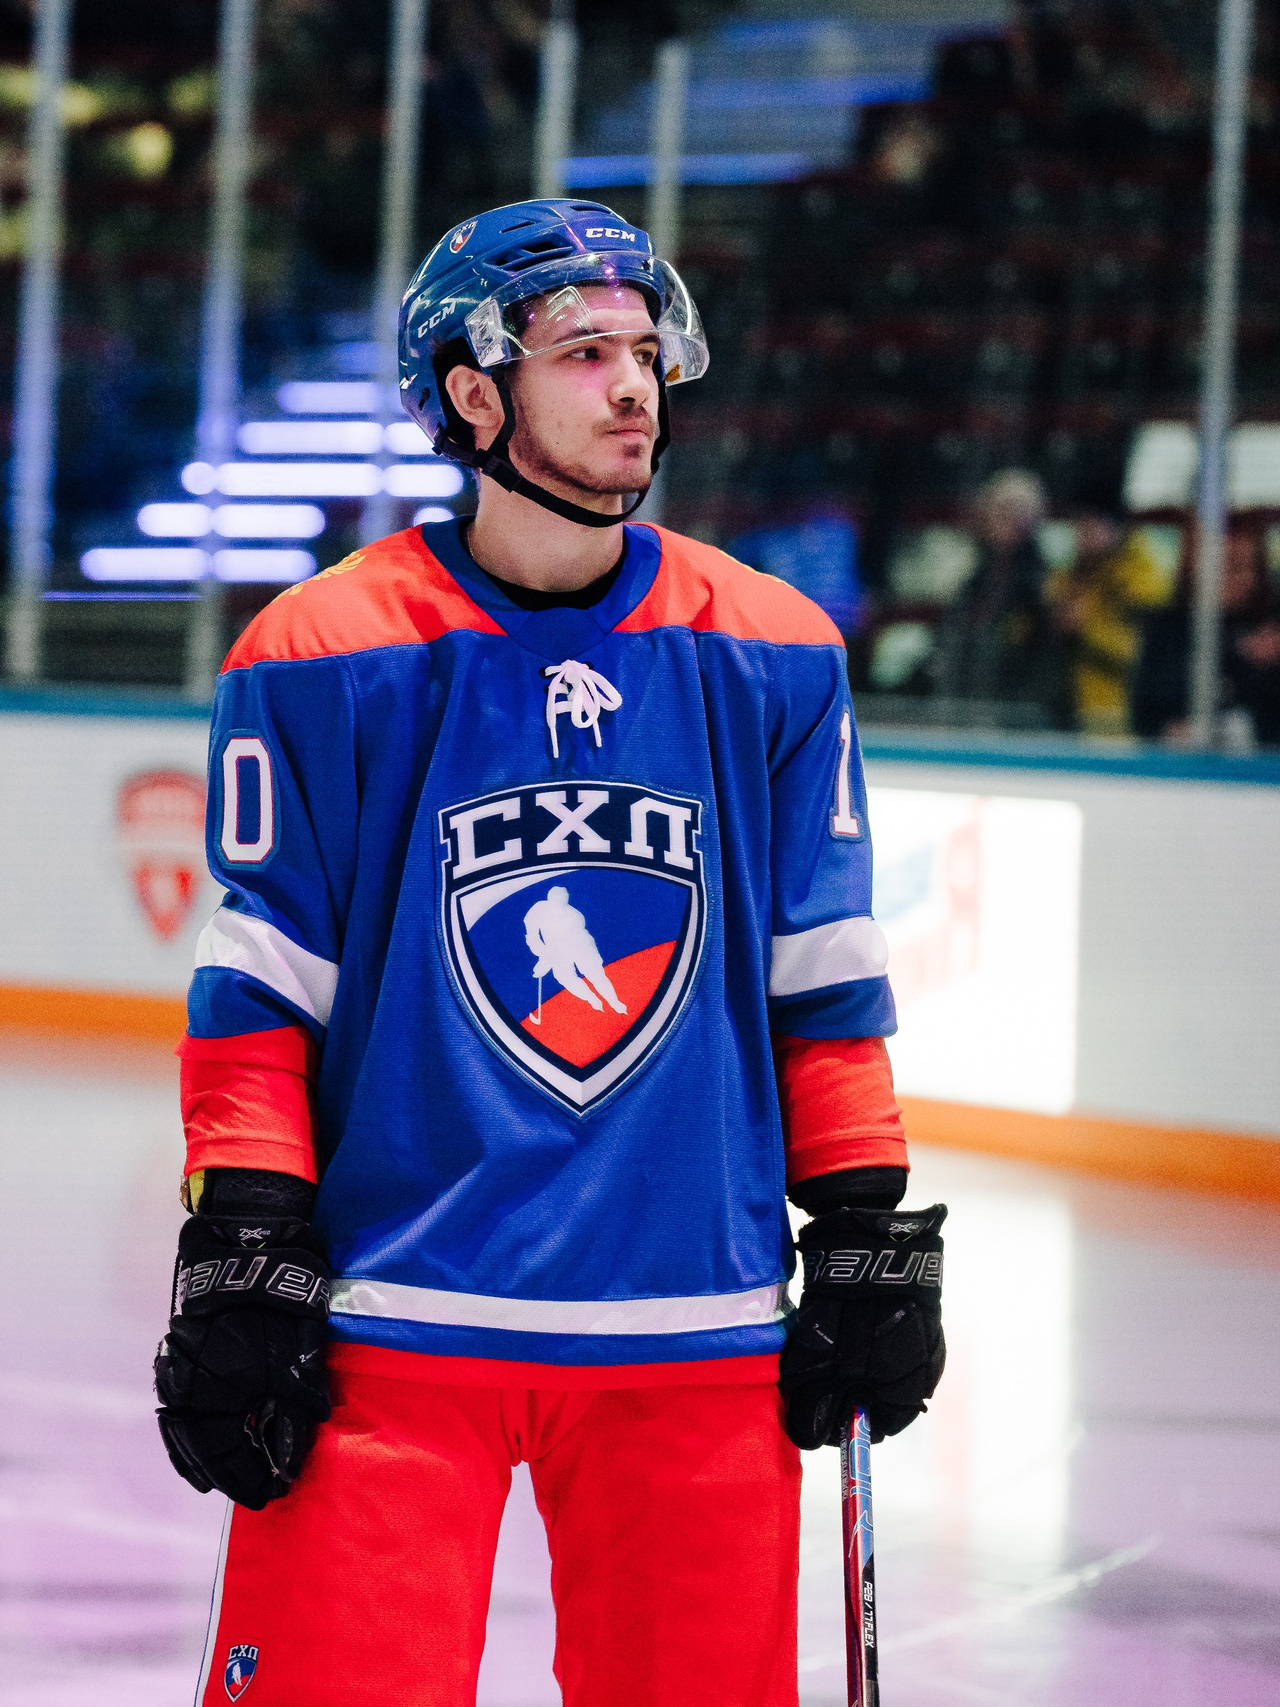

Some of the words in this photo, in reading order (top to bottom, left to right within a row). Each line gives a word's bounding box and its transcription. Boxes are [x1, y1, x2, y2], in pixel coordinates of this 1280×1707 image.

[585, 227, 636, 242] CCM
[417, 302, 456, 339] CCM
[221, 737, 273, 863] 0
[833, 711, 859, 835] 1
